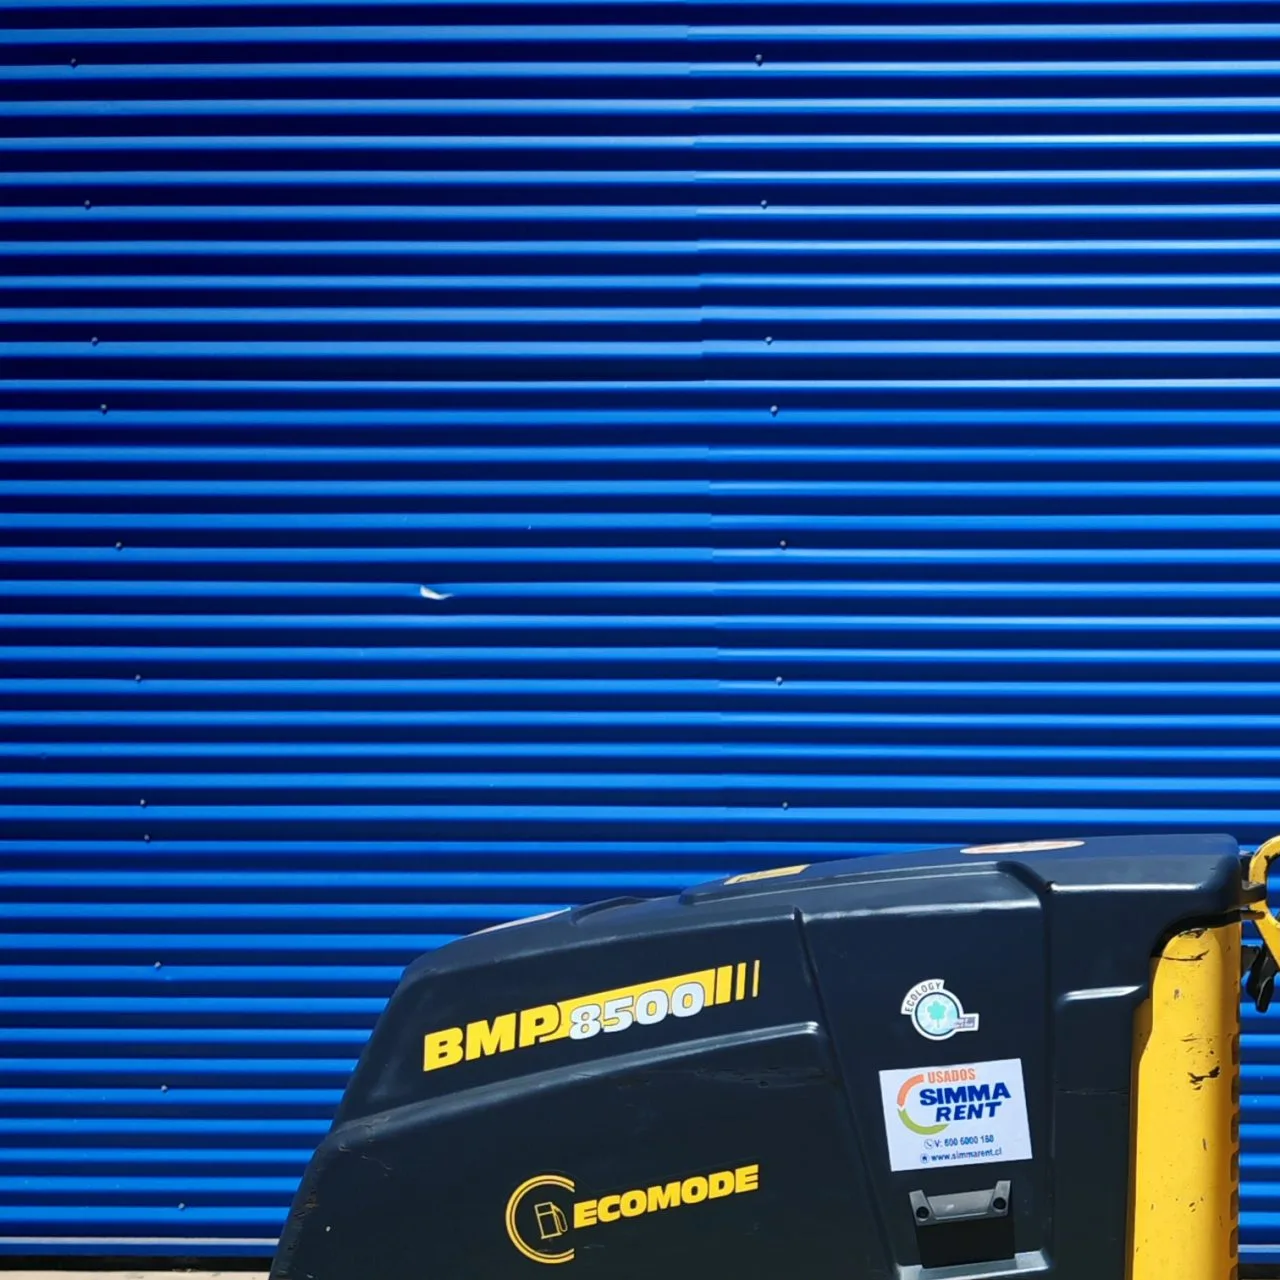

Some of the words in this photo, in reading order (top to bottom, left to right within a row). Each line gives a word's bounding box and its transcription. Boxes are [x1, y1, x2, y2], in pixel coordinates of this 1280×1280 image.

[905, 981, 942, 1013] ECOLOGY
[927, 1067, 976, 1084] USADOS
[919, 1082, 1012, 1106] SIMMA
[935, 1101, 1003, 1123] RENT
[931, 1147, 1003, 1162] www.simmarent.cl
[573, 1164, 759, 1229] ECOMODE
